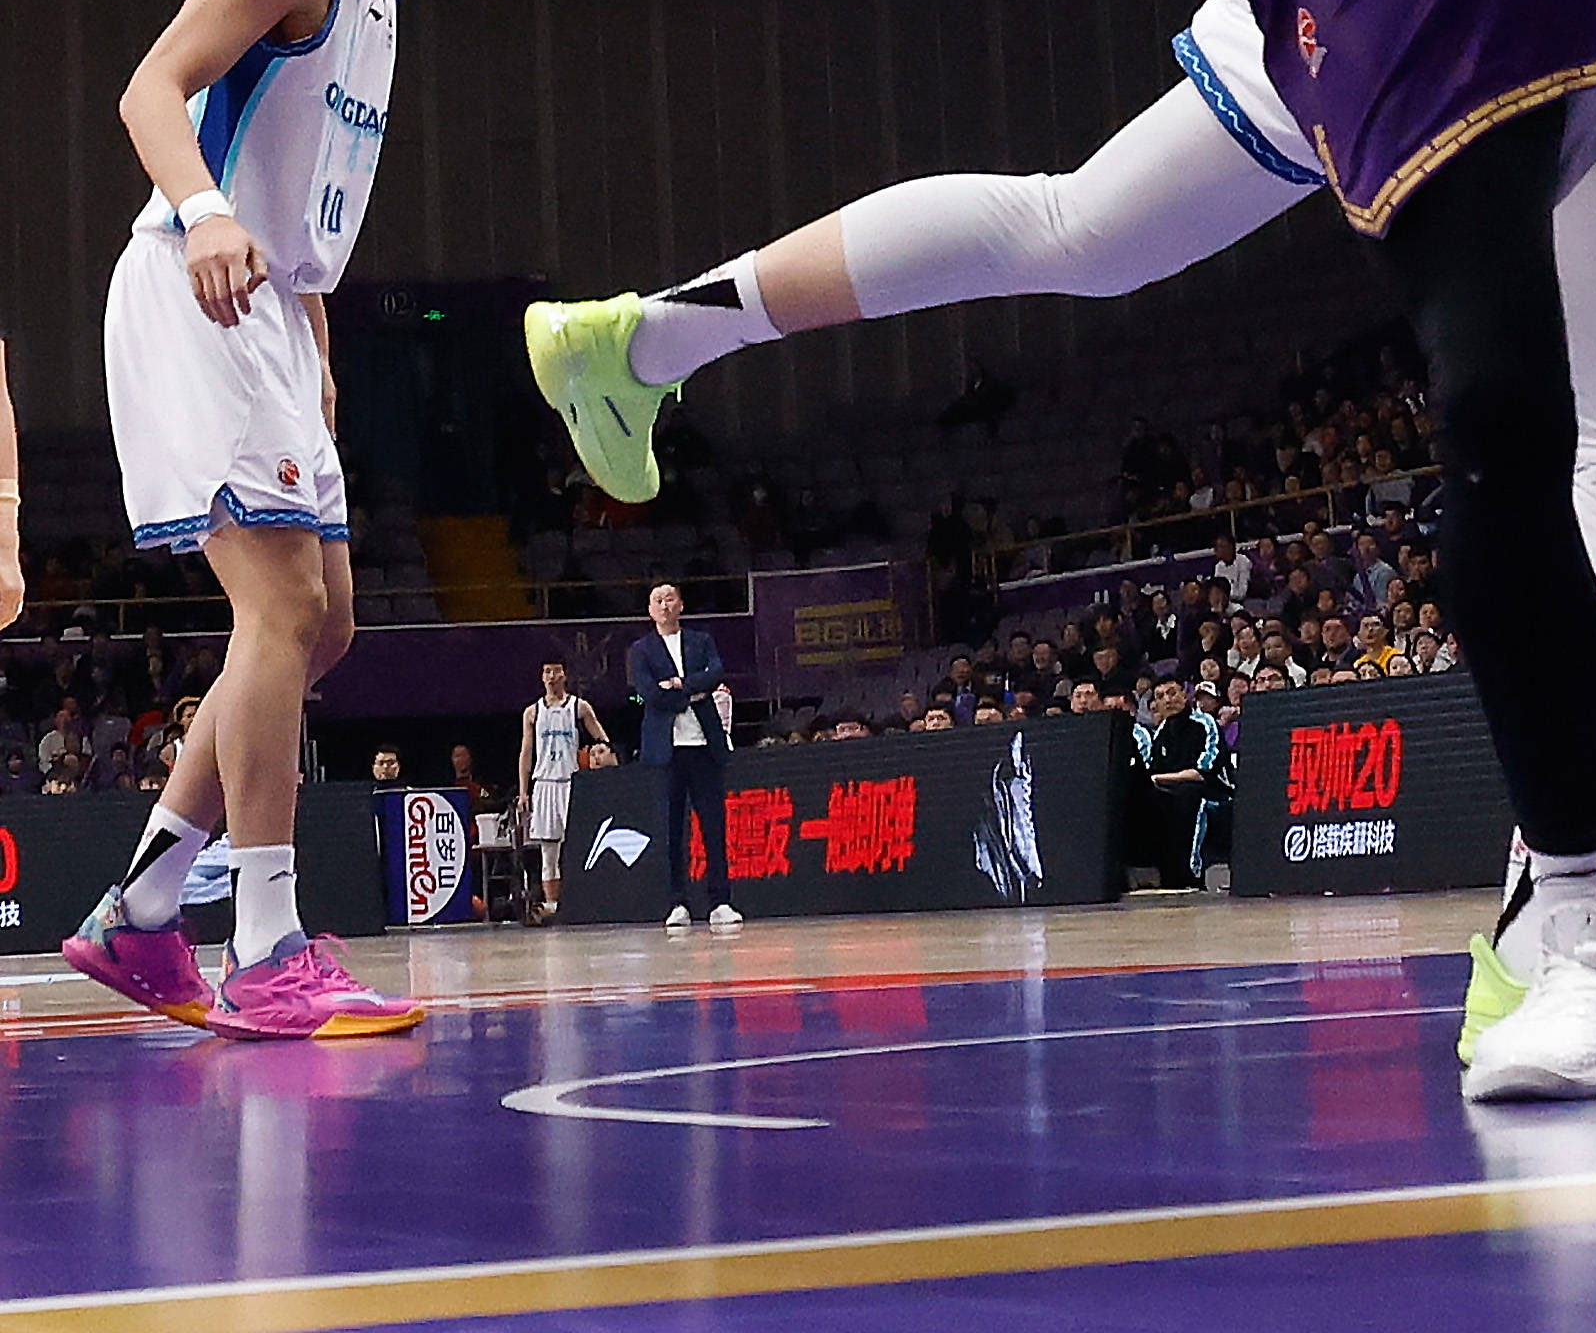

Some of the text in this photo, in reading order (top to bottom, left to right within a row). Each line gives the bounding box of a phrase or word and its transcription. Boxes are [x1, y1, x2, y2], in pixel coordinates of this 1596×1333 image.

[319, 182, 345, 235] 10
[435, 811, 456, 889] 百岁山
